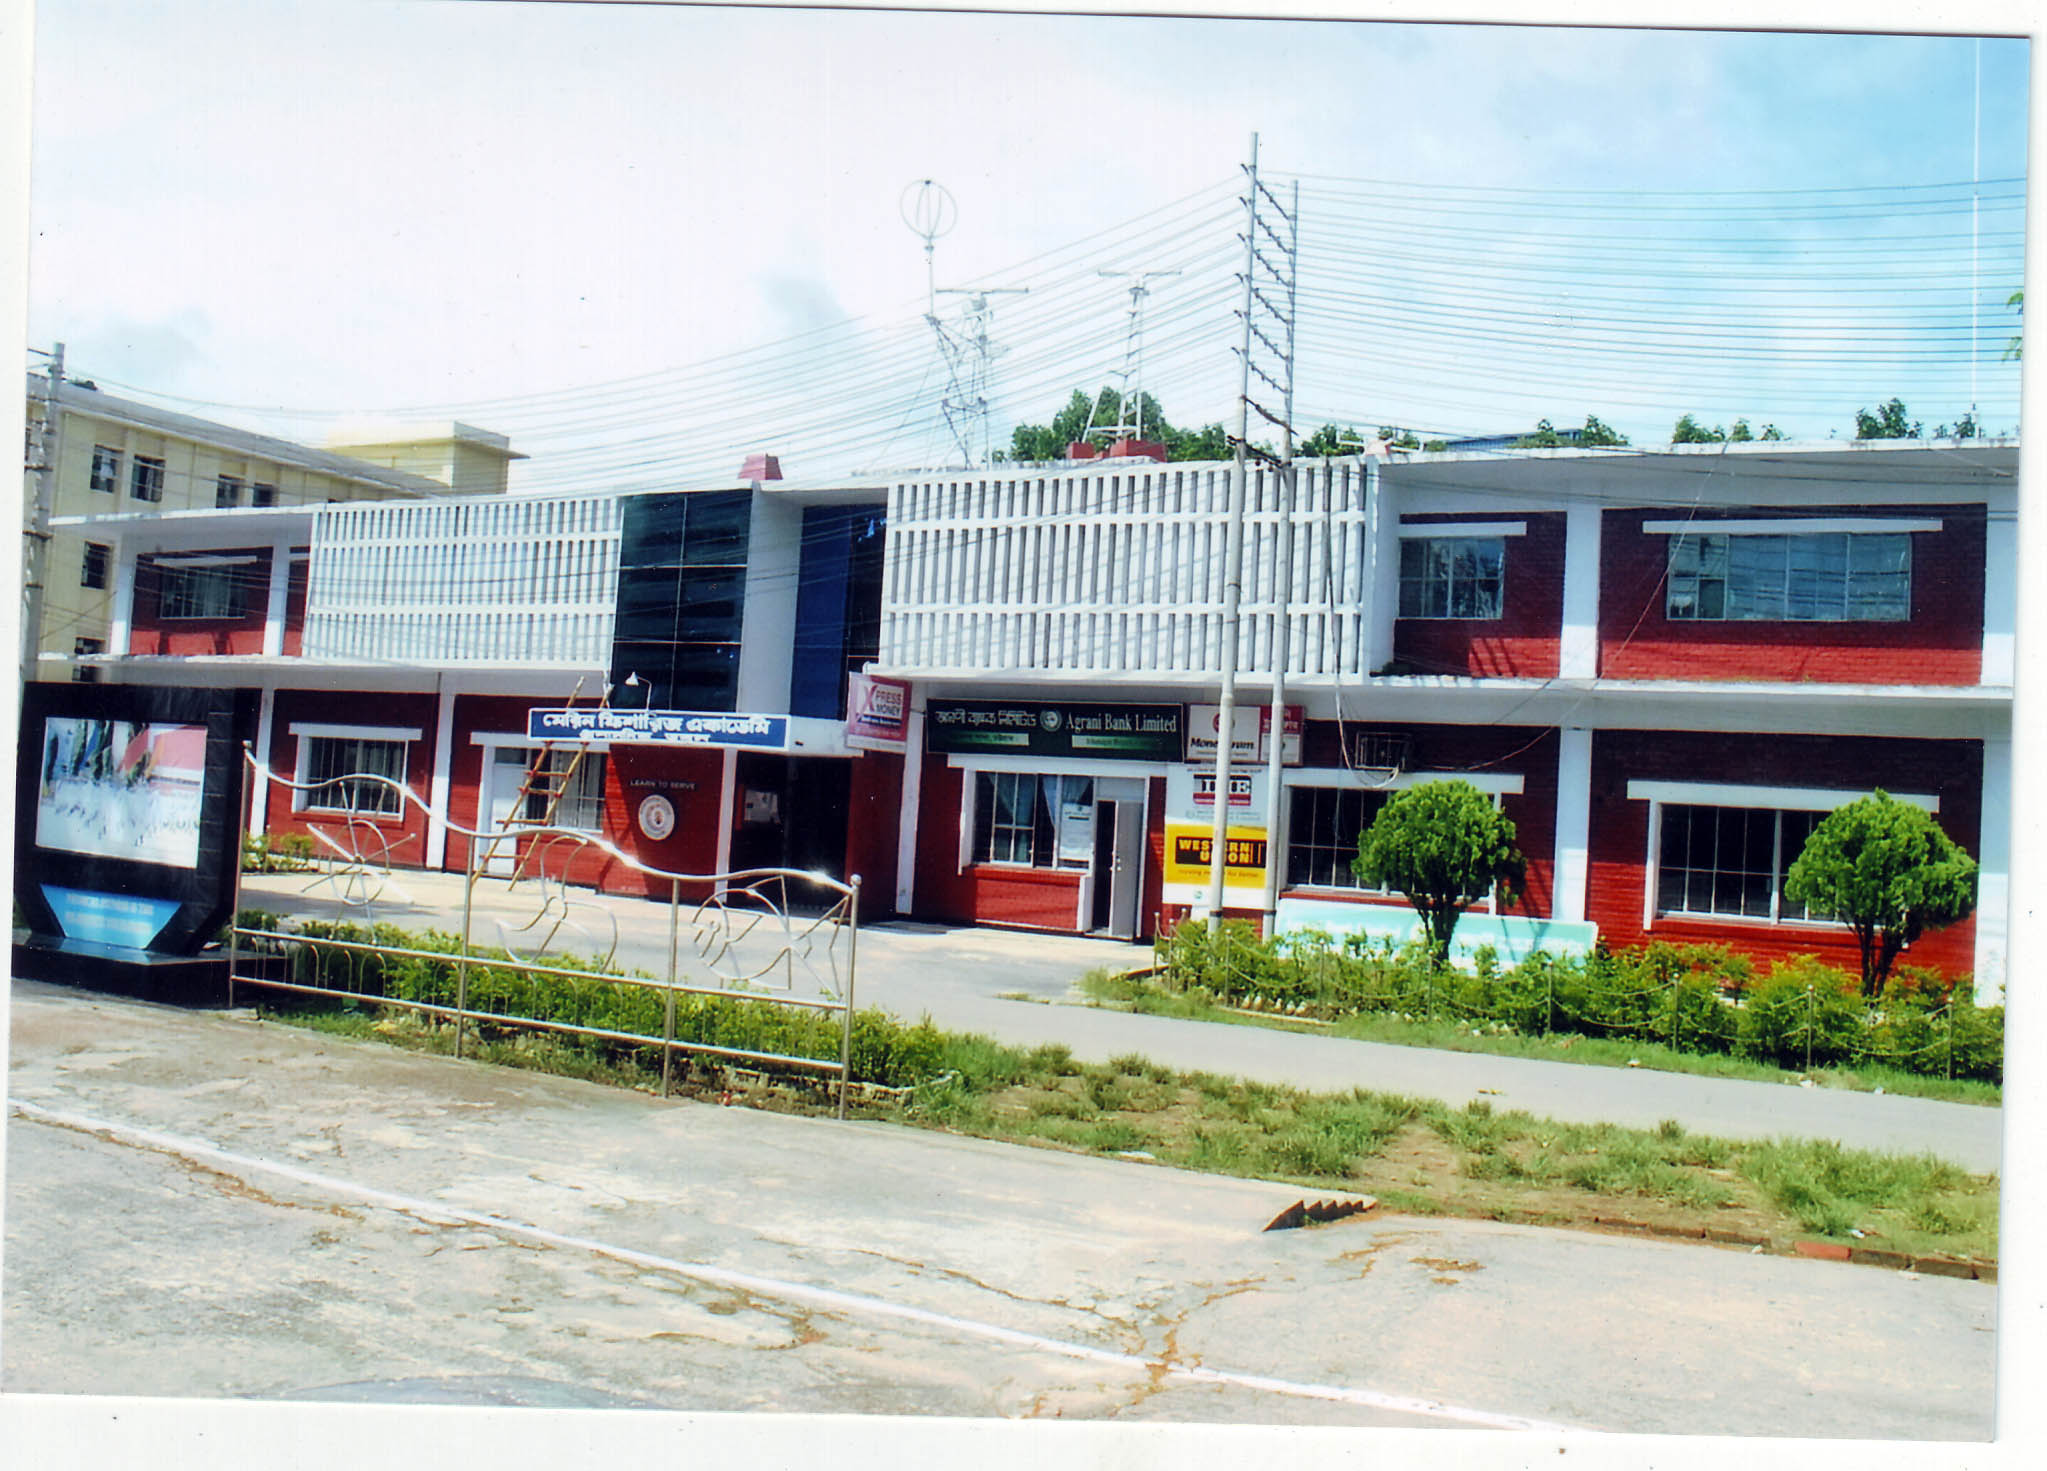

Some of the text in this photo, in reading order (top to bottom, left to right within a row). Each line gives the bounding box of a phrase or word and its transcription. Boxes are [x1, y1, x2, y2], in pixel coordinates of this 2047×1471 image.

[1066, 712, 1177, 734] Agrani Bank Limited
[630, 780, 656, 788] LEARN
[670, 782, 696, 790] SERVE
[1178, 839, 1250, 852] WESRN
